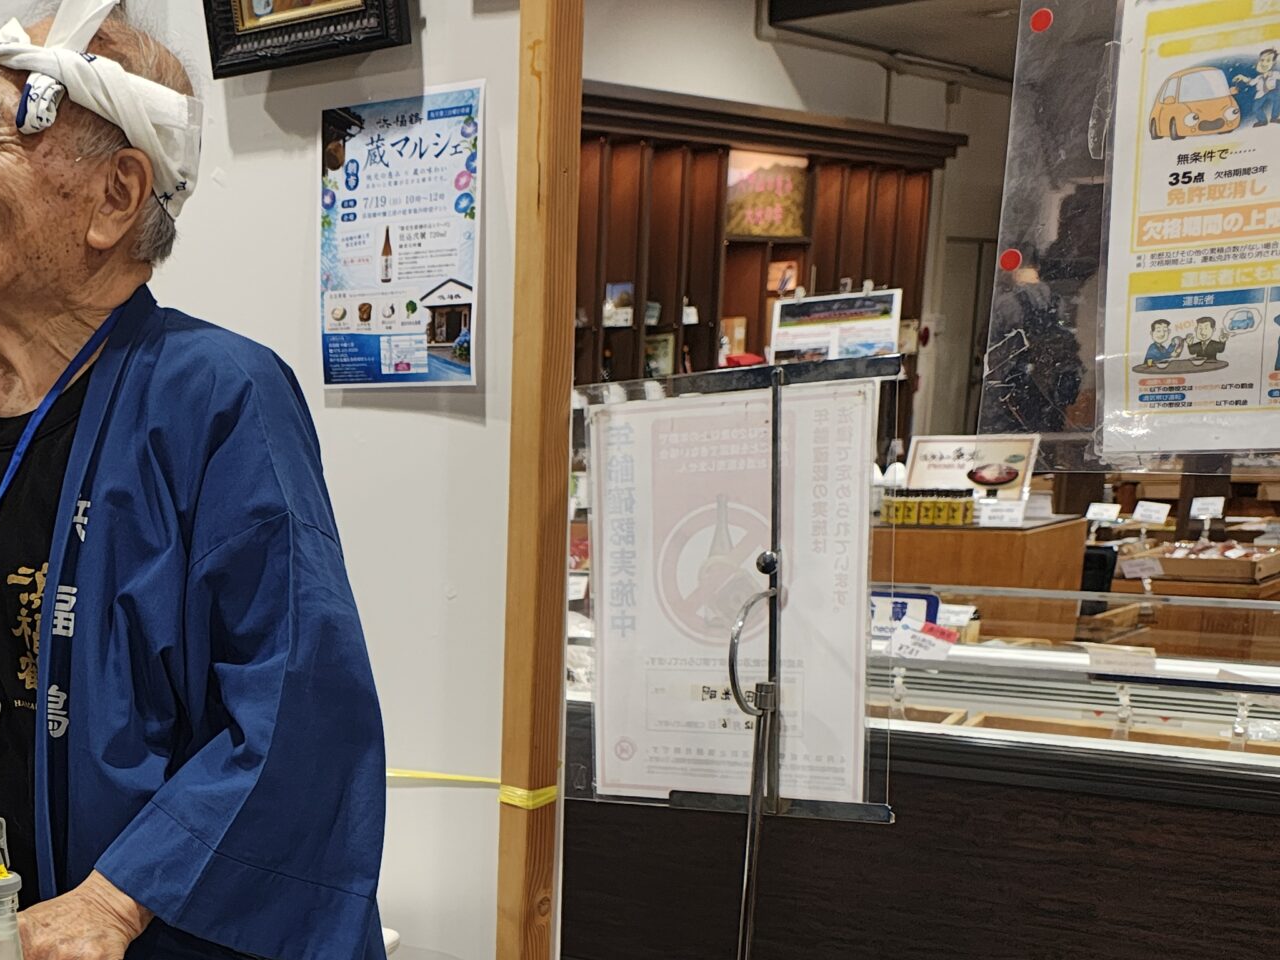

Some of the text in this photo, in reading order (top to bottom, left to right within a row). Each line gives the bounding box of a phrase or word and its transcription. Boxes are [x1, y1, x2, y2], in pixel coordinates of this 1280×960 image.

[363, 133, 463, 171] 蔵マルシェ
[1168, 165, 1268, 187] 35点 欠格期間3年
[1167, 179, 1268, 206] 免許取消し
[1182, 294, 1215, 306] 運転者
